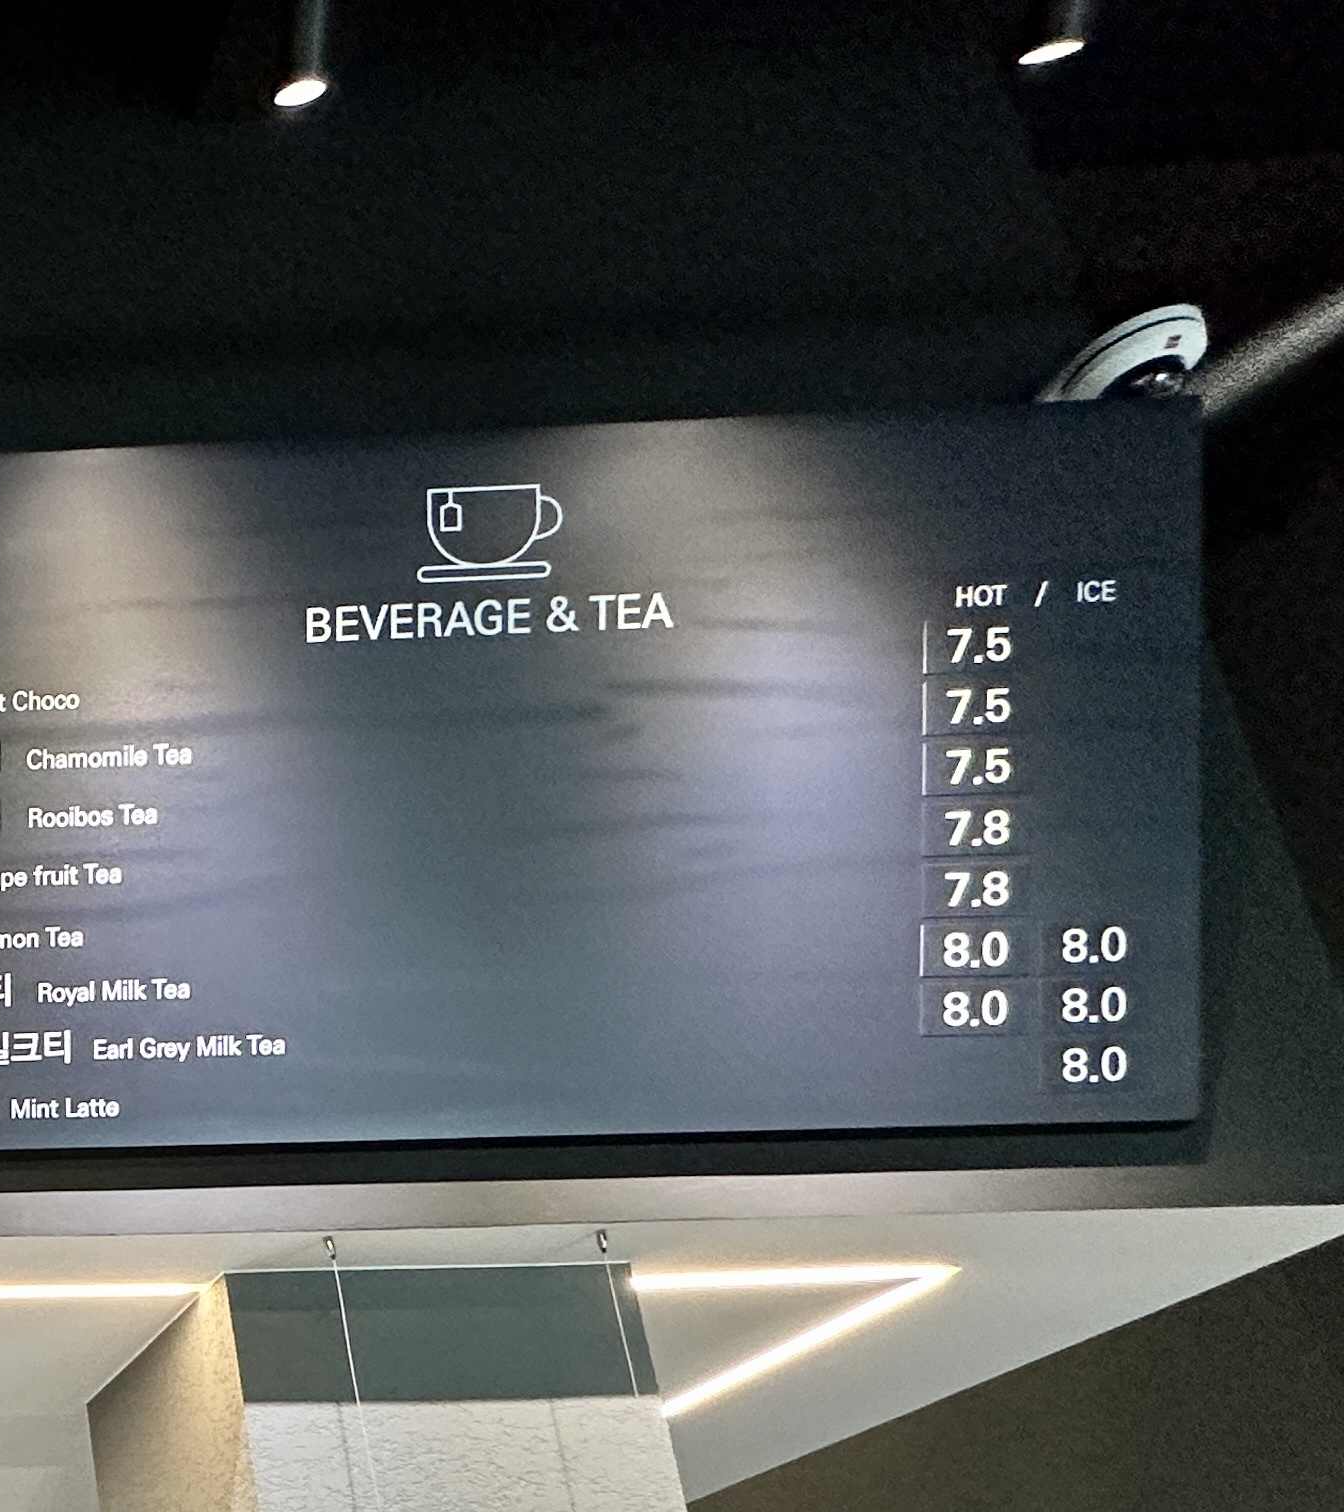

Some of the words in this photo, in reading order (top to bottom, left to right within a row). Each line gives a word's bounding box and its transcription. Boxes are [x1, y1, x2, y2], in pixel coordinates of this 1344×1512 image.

[955, 585, 1007, 607] HOT
[1078, 580, 1116, 602] ICE
[307, 599, 531, 643] BEVERAGE
[547, 596, 579, 632] &
[589, 593, 673, 630] TEA
[948, 627, 1011, 663] 7.5
[12, 691, 79, 711] Choco
[947, 688, 1011, 724] 7.5
[27, 745, 147, 770] Chamomile
[153, 743, 192, 765] Tea
[29, 806, 113, 828] Rooibos
[118, 804, 157, 825] Tea
[945, 809, 1010, 846] 7.8
[33, 865, 78, 885] fruit
[83, 863, 122, 884] Tea
[945, 871, 1009, 907] 7.8
[45, 927, 83, 947] Tea
[944, 931, 1009, 968] 8.0
[1063, 926, 1126, 963] 8.0
[38, 981, 95, 1006] Royal
[102, 979, 147, 1001] Milk
[151, 978, 190, 999] Tea
[943, 990, 1008, 1027] 8.0
[1063, 987, 1126, 1023] 8.0
[94, 1038, 133, 1060] Earl
[140, 1038, 190, 1062] Grey
[197, 1035, 242, 1057] Milk
[246, 1034, 285, 1055] Tea
[11, 1098, 59, 1119] Mint
[66, 1098, 119, 1117] Latte
